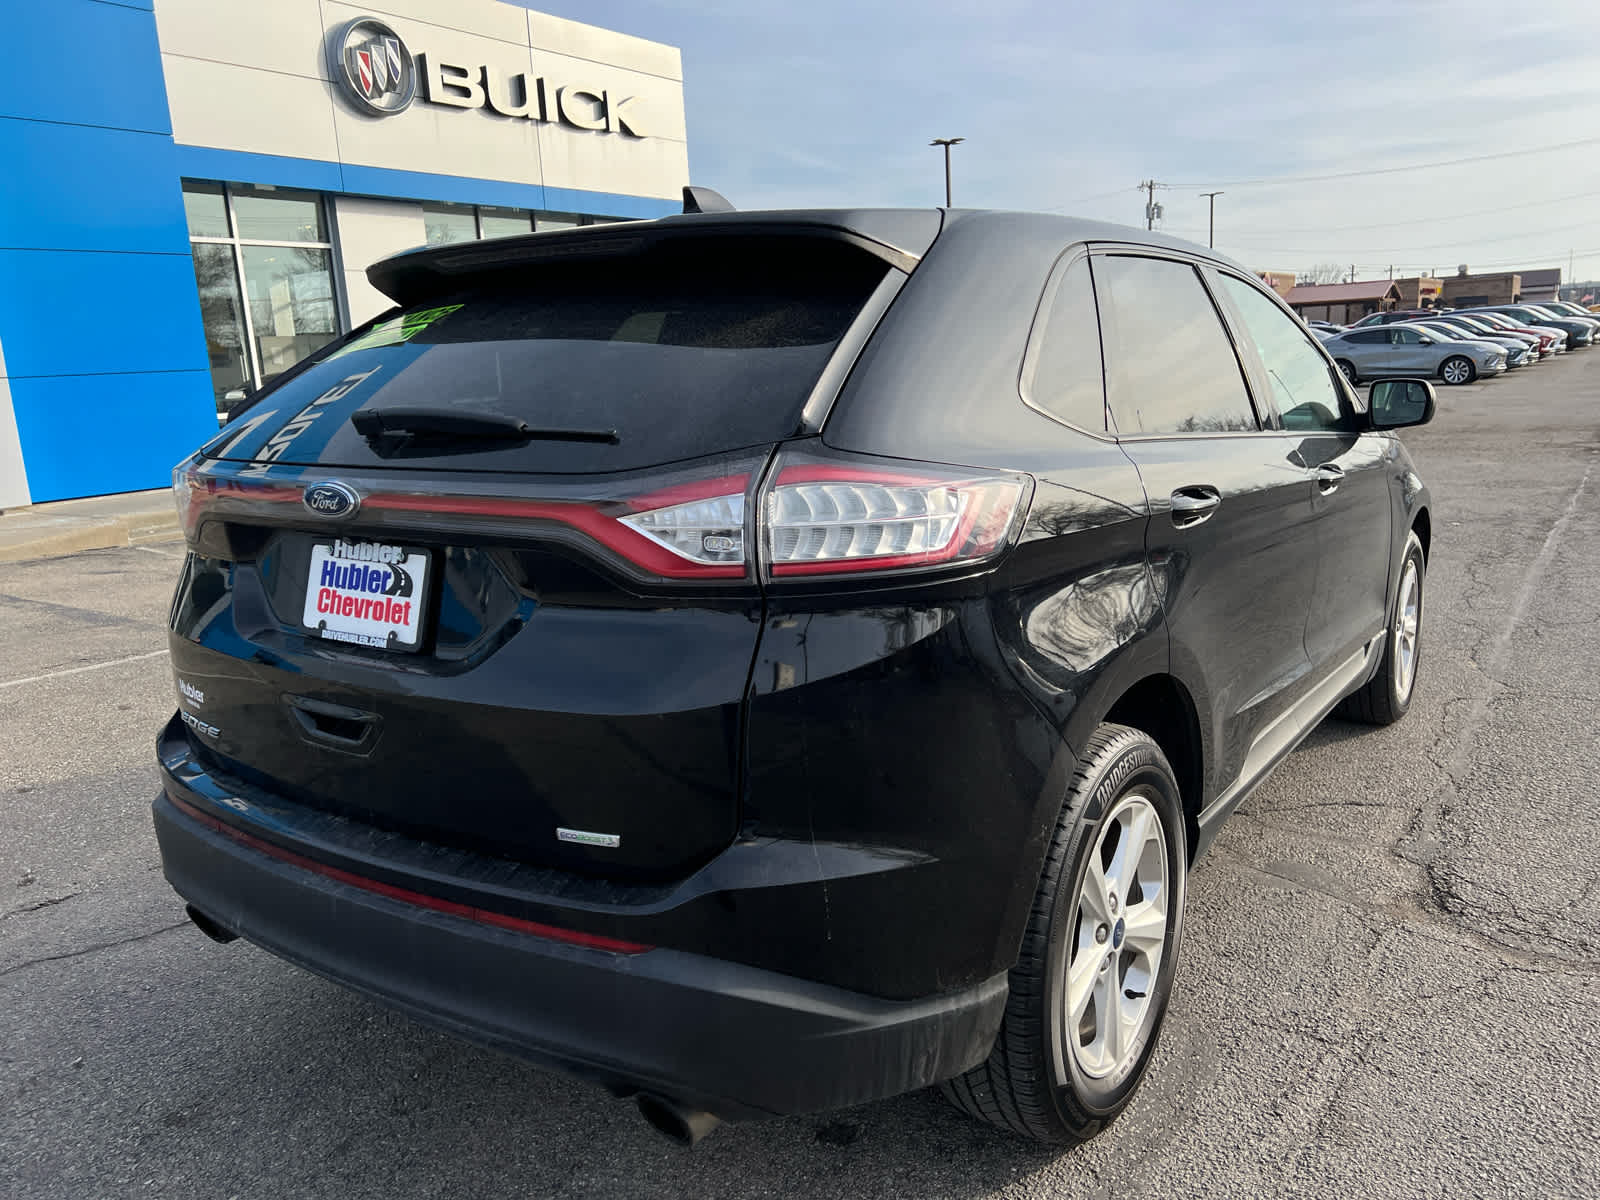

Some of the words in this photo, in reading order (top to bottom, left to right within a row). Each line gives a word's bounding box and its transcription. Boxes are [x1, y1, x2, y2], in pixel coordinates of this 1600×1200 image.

[414, 52, 647, 138] BUICK
[311, 489, 339, 510] Ford
[334, 539, 403, 564] Hubler
[320, 559, 392, 594] Hubler
[317, 588, 411, 626] Chevrolet
[181, 711, 221, 738] EDGE
